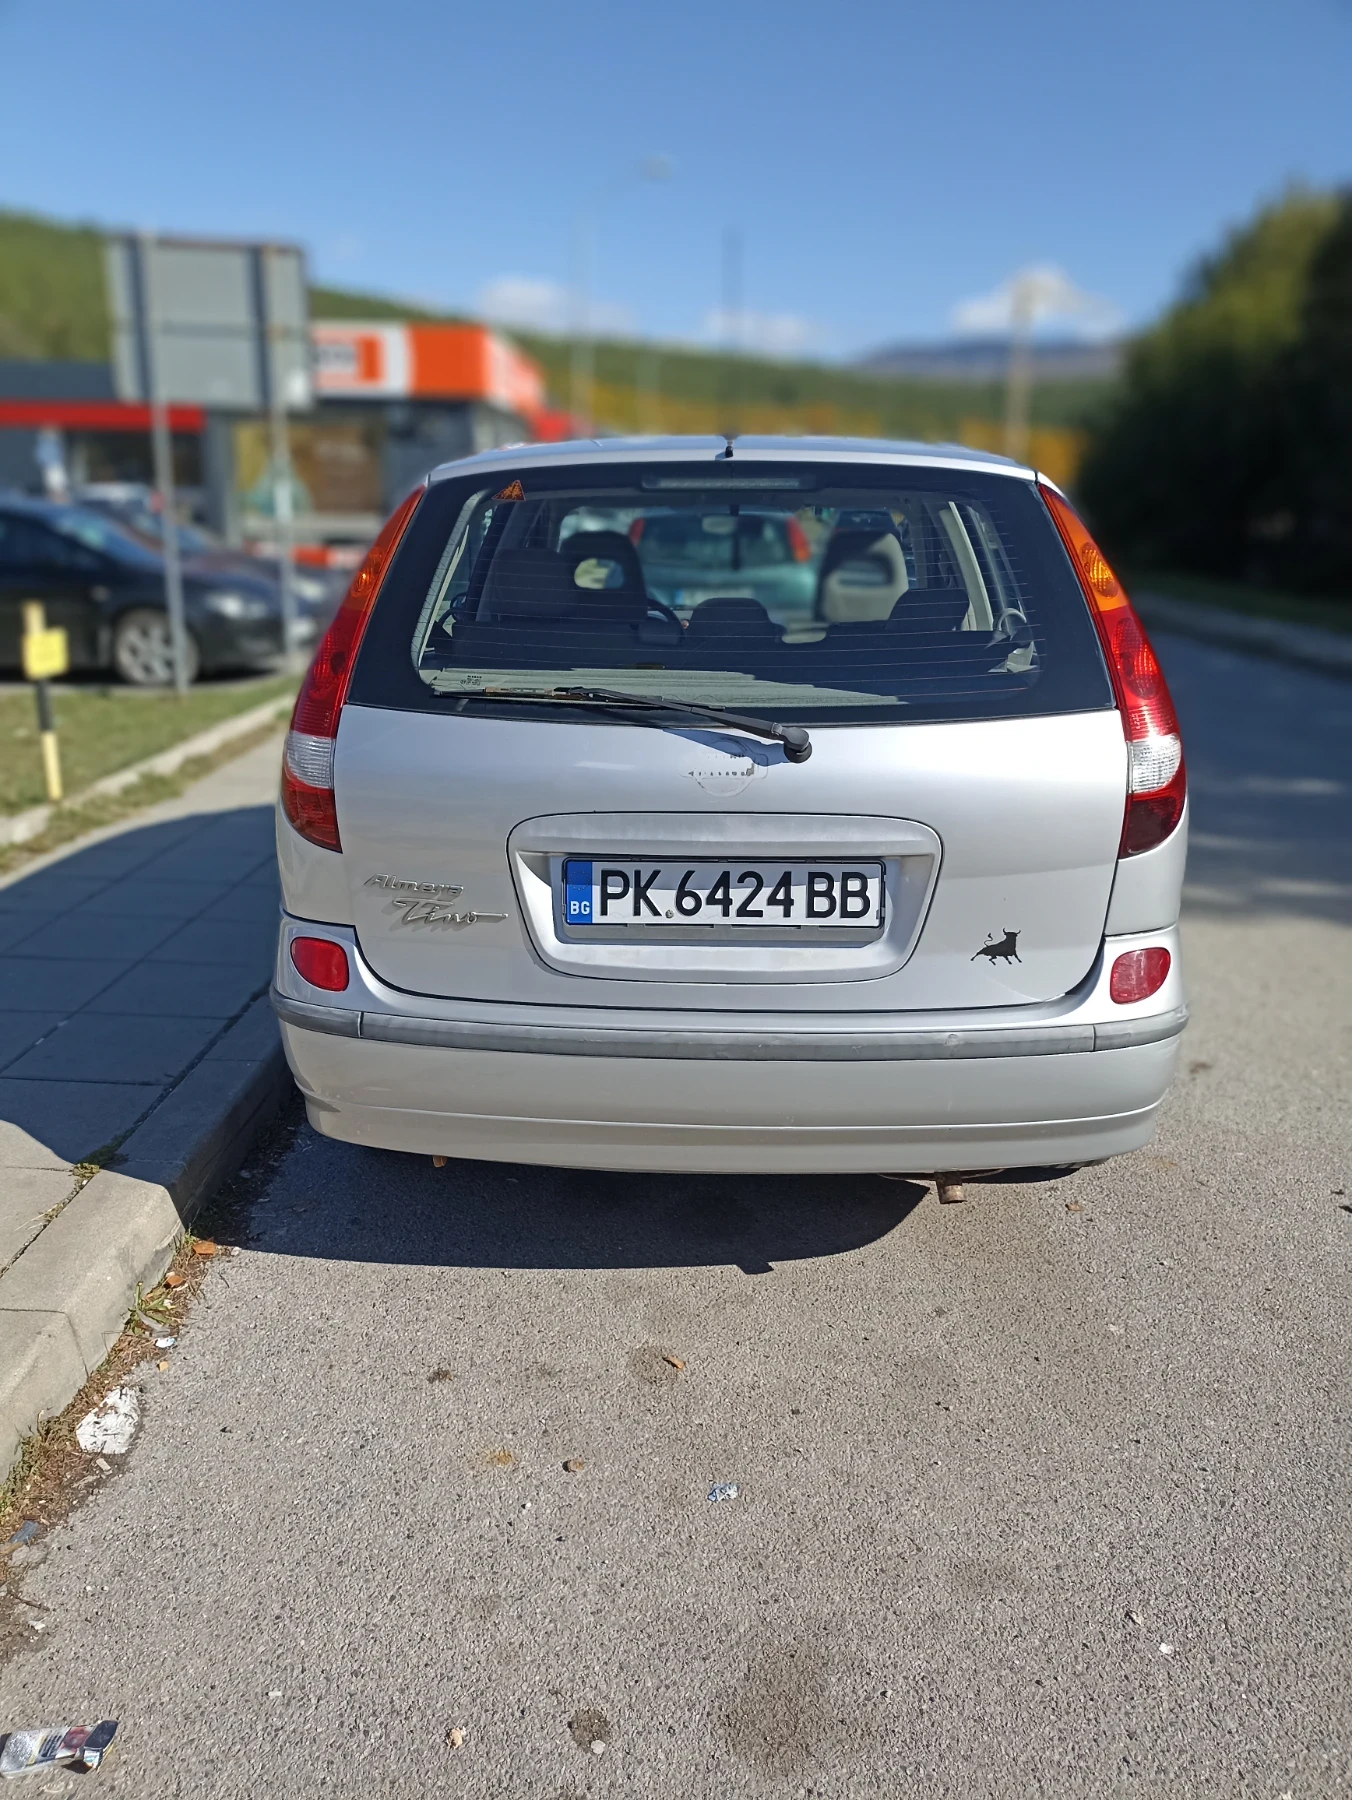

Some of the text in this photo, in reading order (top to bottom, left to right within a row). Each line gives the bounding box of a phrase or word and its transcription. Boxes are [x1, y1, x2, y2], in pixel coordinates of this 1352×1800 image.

[570, 900, 590, 915] BG
[600, 869, 871, 919] PK 6424 BB
[392, 897, 509, 925] Tino
